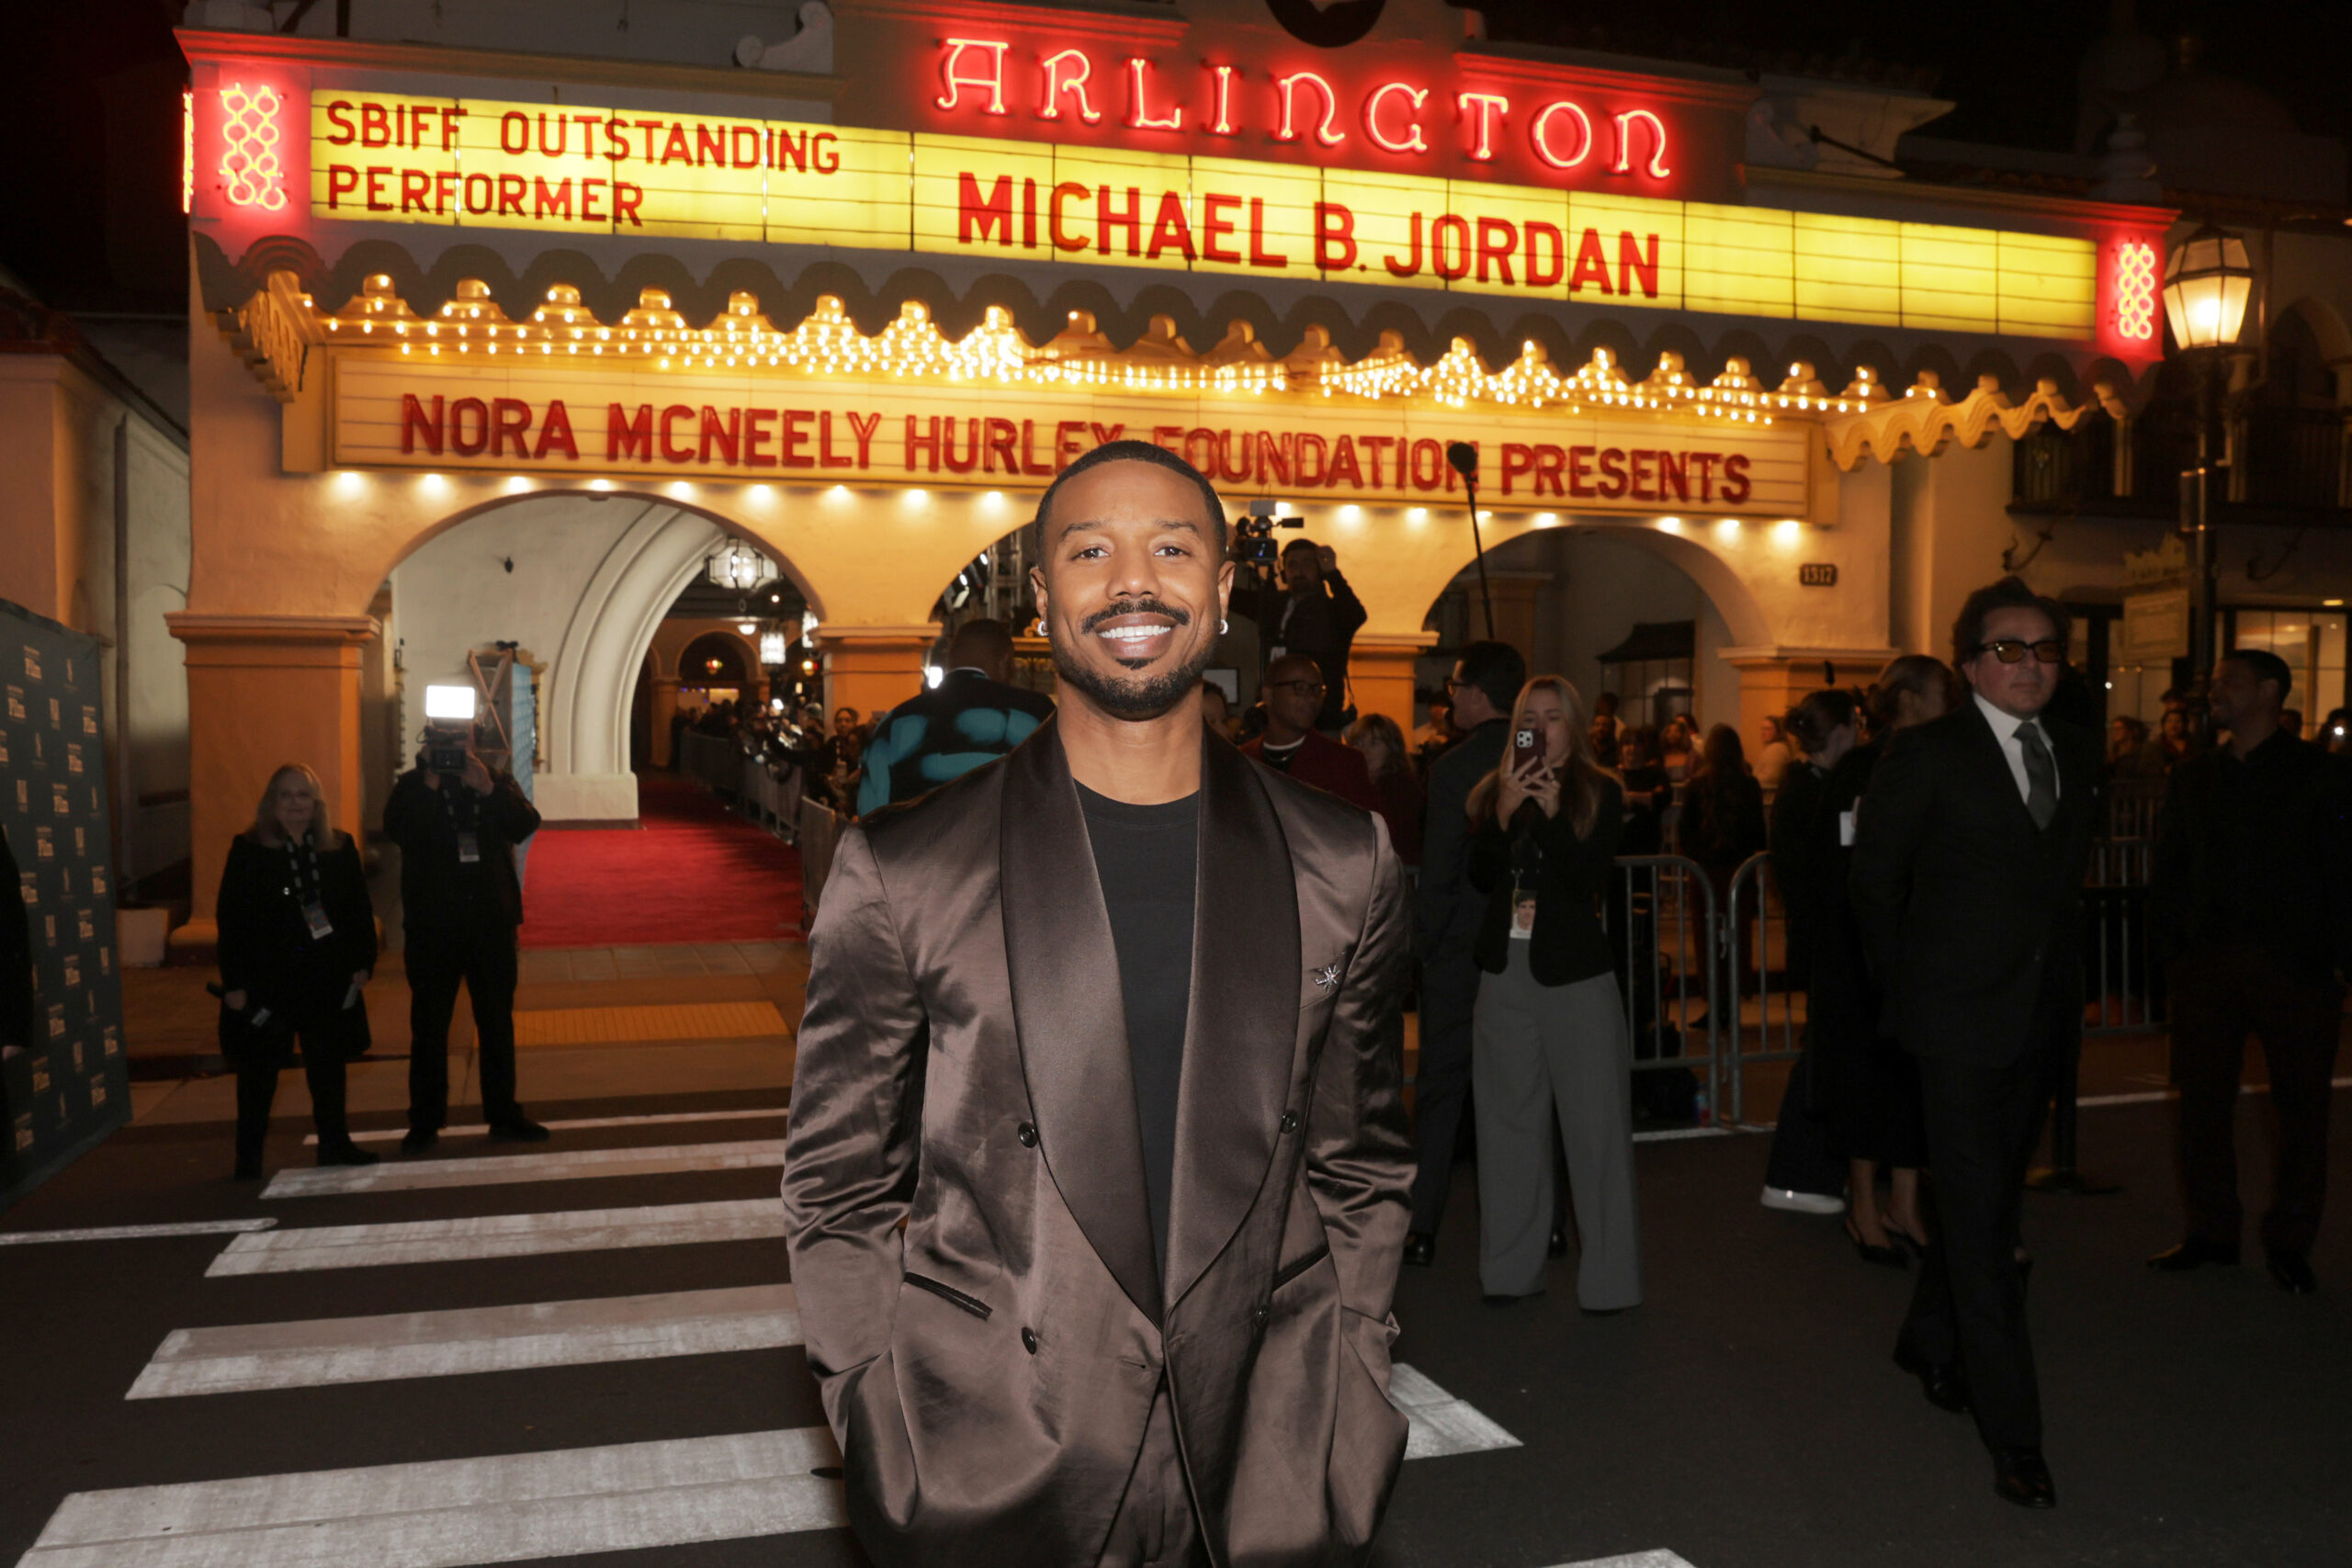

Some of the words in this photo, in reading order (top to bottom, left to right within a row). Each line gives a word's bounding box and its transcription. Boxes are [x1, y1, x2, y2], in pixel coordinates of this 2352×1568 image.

[326, 100, 468, 152] SBIFF
[501, 111, 841, 175] OUTSTANDING
[935, 38, 1671, 178] ARLINGTON
[327, 164, 643, 227] PERFORMER
[957, 172, 1288, 267] MICHAEL
[1313, 200, 1368, 273] B.
[1384, 211, 1658, 299] JORDAN
[401, 393, 579, 461] NORA
[606, 403, 881, 469] MCNEELY
[1500, 442, 1752, 504] PRESENTS
